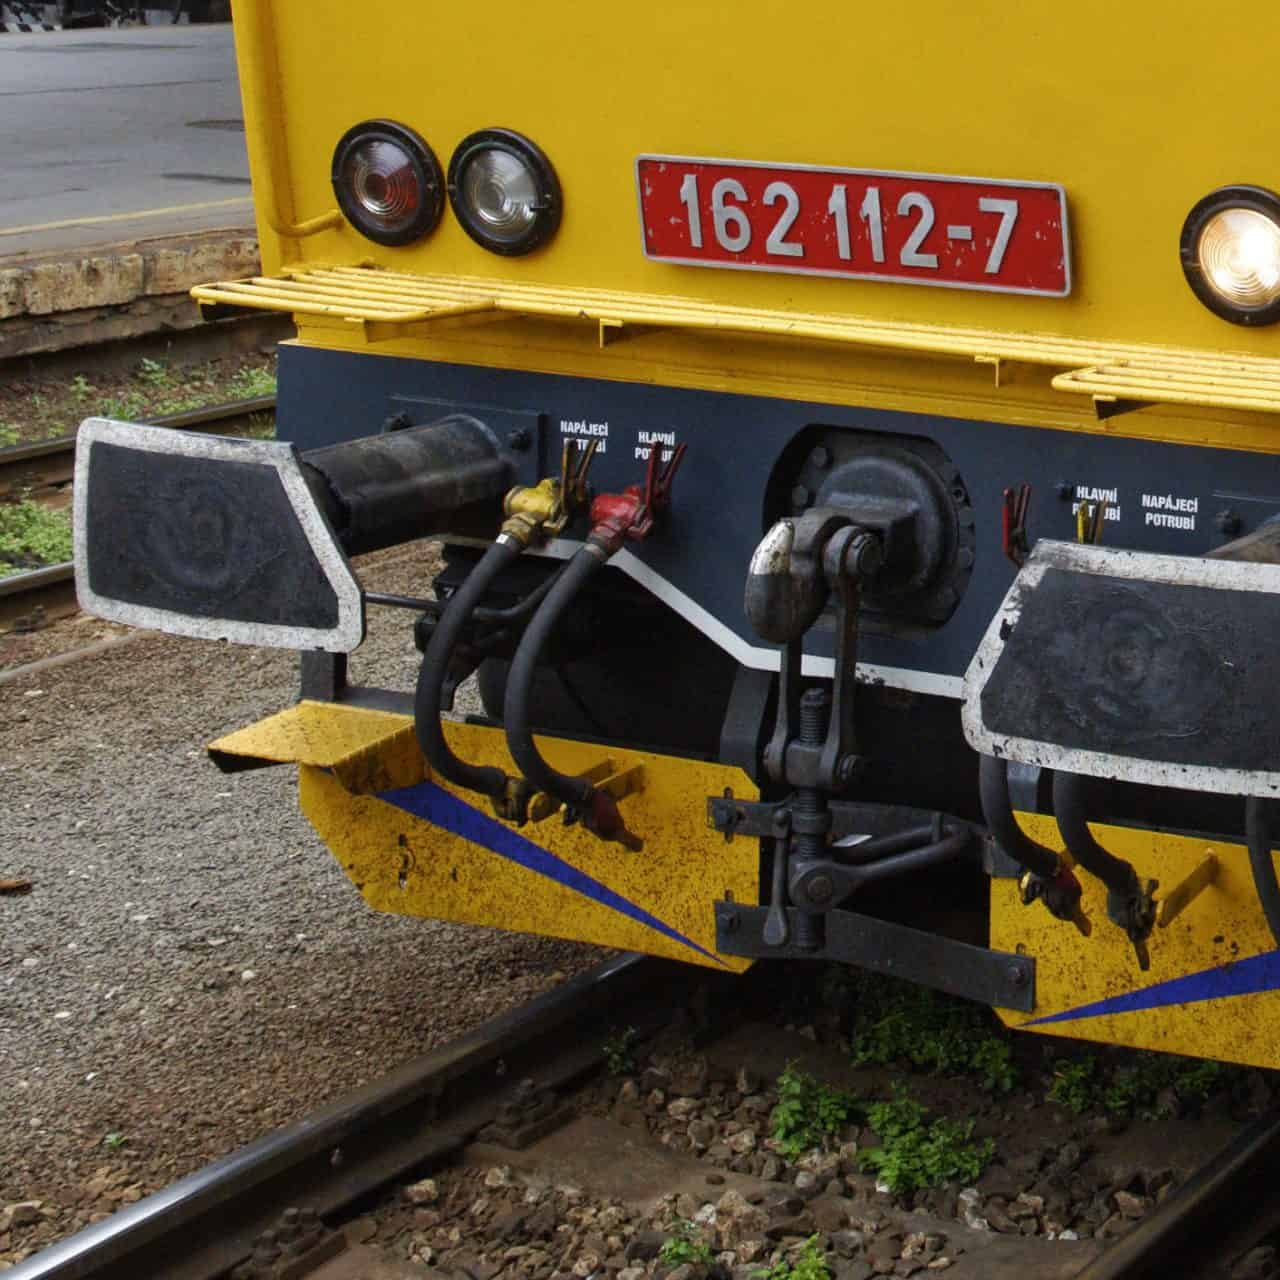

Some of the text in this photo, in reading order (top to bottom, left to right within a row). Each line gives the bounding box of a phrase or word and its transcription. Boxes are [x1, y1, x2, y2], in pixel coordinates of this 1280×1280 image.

[680, 174, 1018, 274] 162 112-7
[560, 421, 608, 436] NAPÁJECÍ
[638, 431, 675, 445] HLAVNÍ
[1076, 486, 1118, 503] HLAVNÍ
[1142, 494, 1199, 513] NAPÁJECÍ
[1145, 512, 1195, 530] POTRUBÍ
